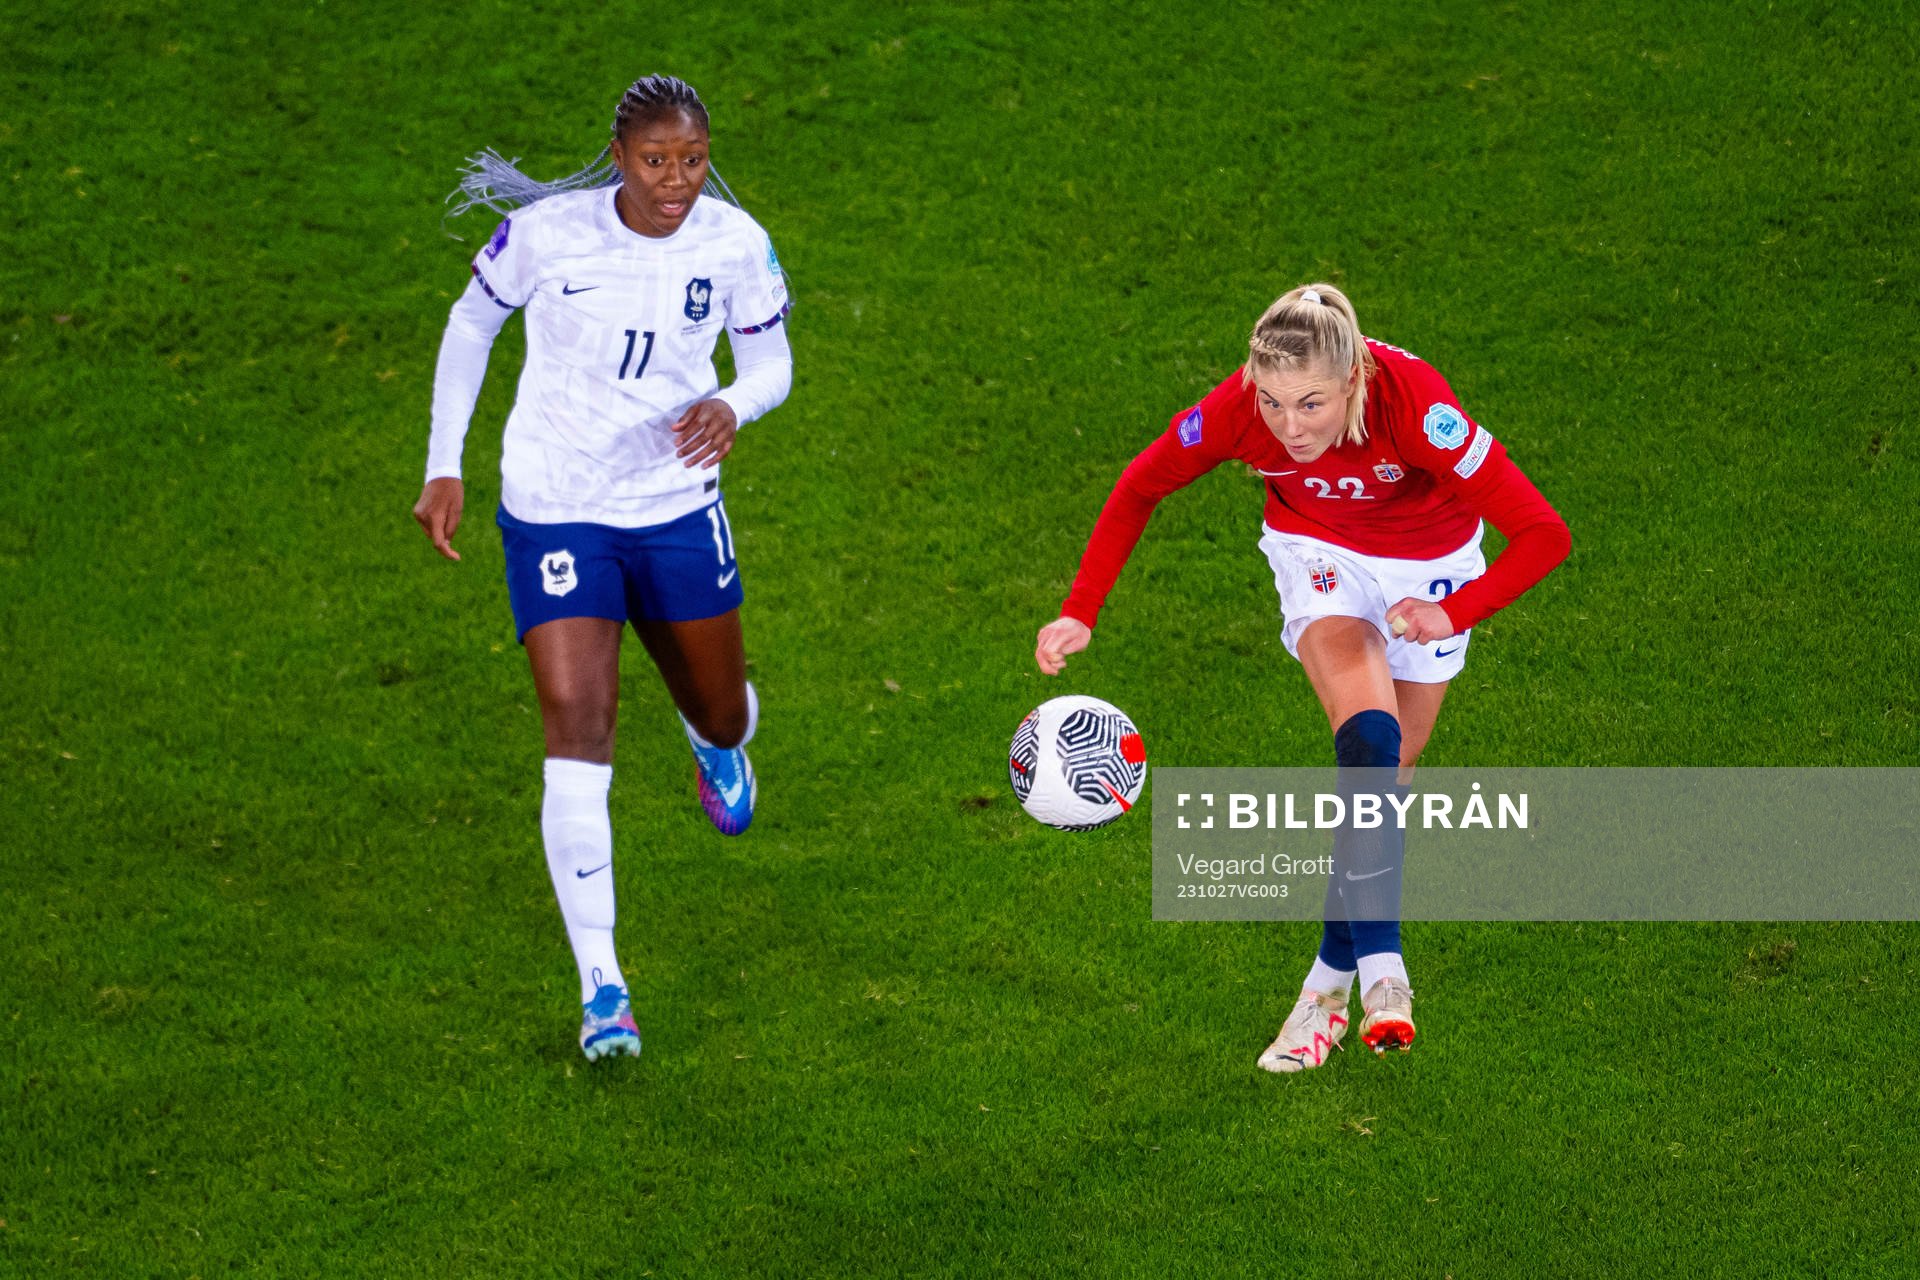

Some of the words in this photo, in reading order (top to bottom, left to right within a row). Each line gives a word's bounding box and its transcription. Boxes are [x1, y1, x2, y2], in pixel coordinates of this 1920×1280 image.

[618, 329, 656, 380] 11
[1304, 477, 1375, 499] 22
[707, 500, 735, 566] 11
